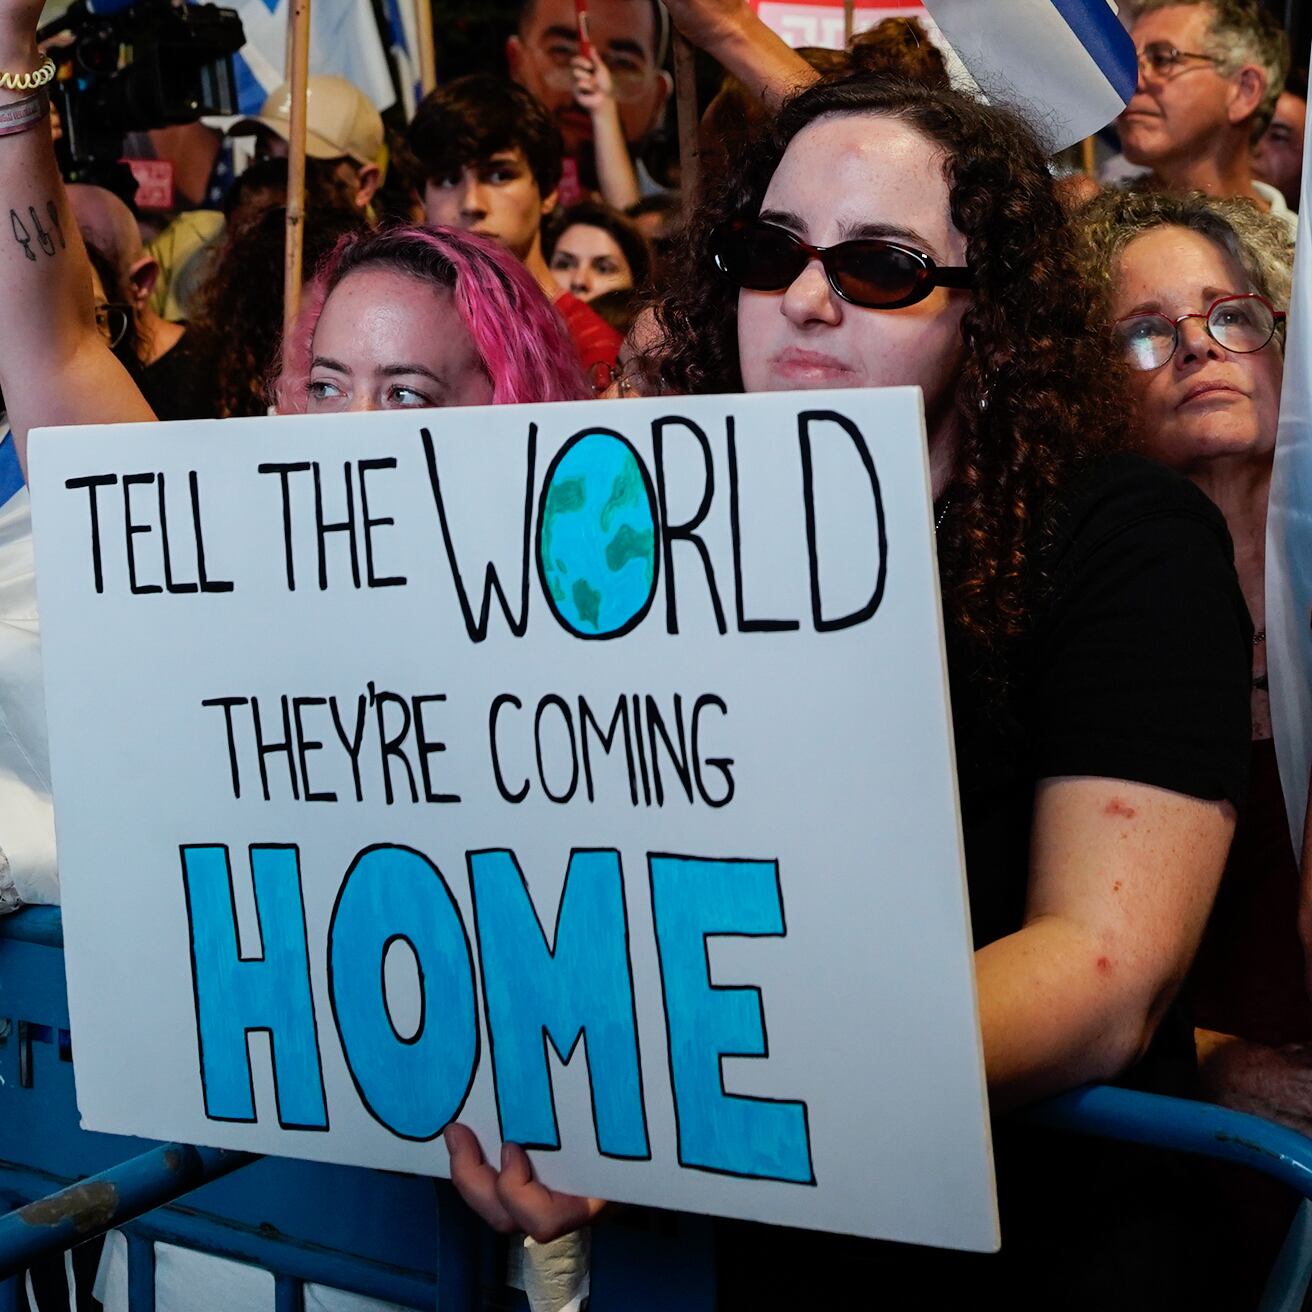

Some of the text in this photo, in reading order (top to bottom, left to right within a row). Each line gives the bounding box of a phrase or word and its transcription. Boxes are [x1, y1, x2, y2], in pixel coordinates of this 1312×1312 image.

[65, 409, 889, 644] TELL THE WORLD
[201, 681, 736, 808] THEY'RE COMING
[179, 841, 817, 1187] HOME
